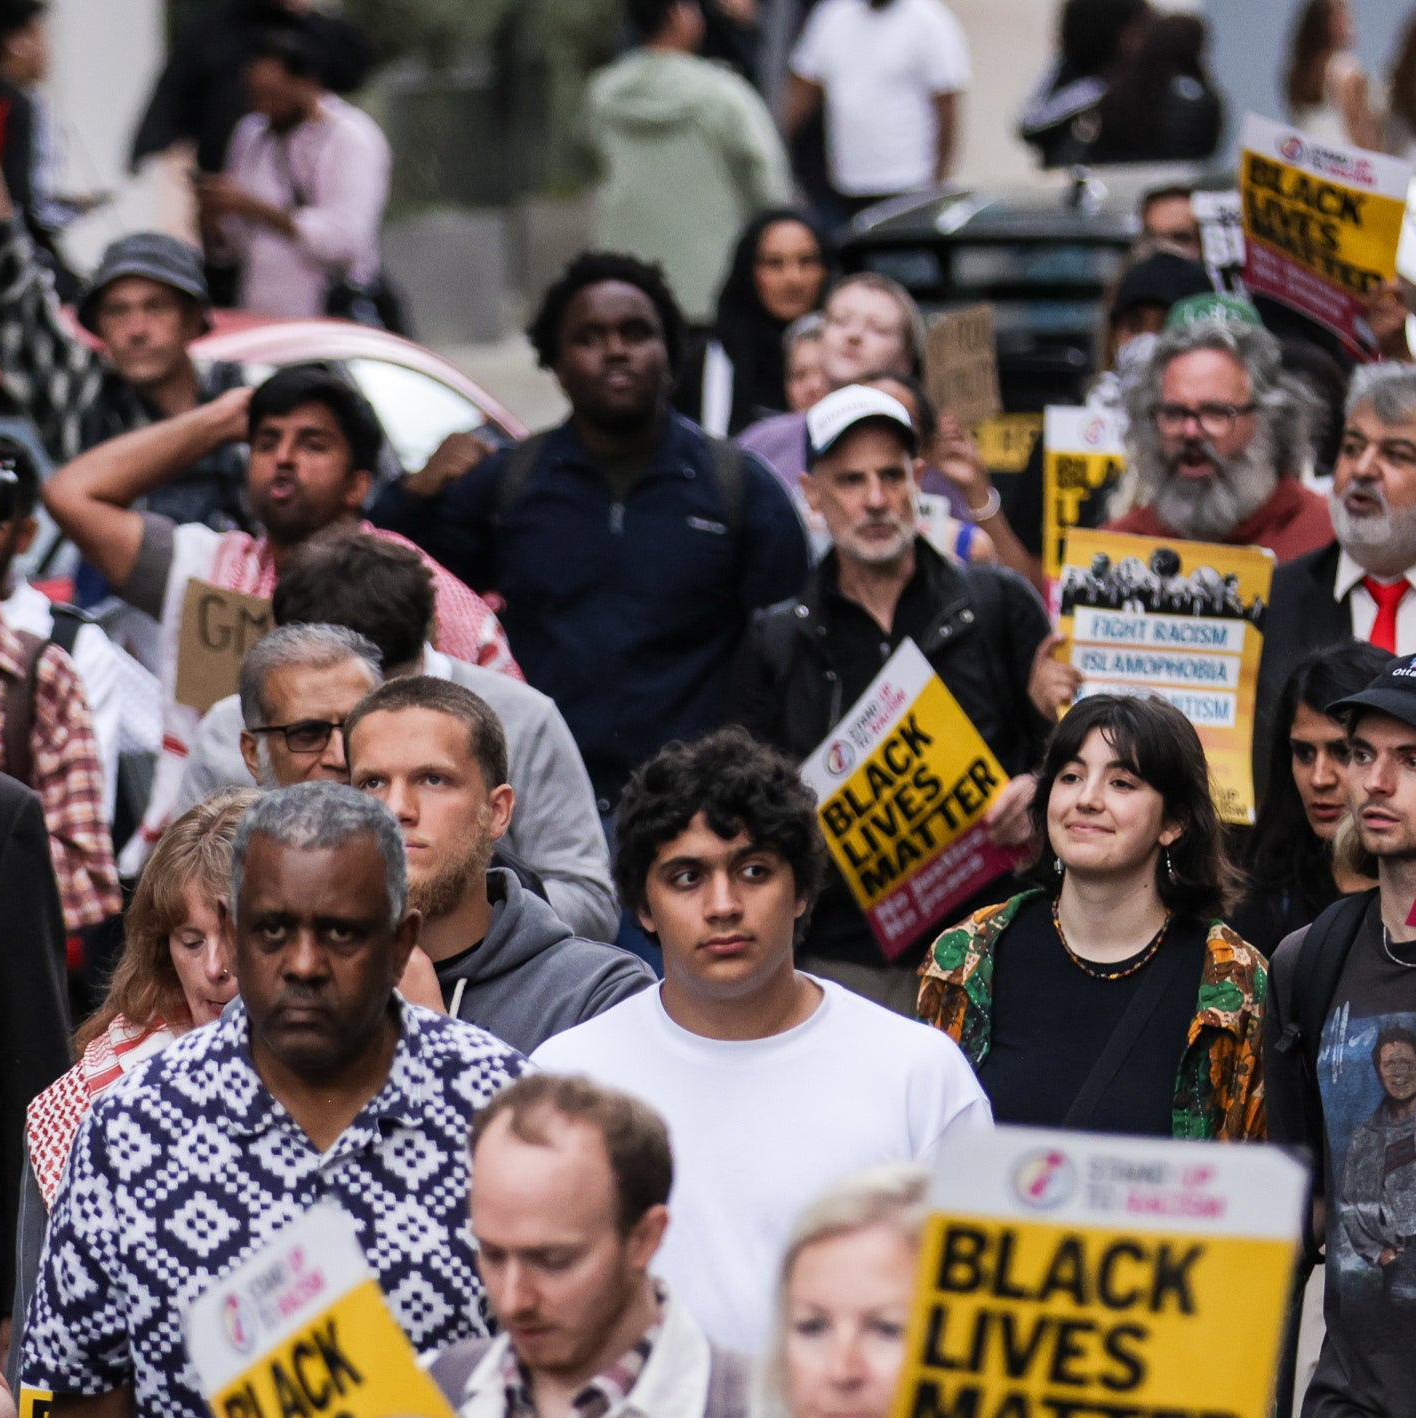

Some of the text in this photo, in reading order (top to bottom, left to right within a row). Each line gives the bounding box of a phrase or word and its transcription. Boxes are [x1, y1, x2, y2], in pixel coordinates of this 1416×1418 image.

[1249, 156, 1367, 226] BLACK
[1092, 614, 1228, 646] FIGHT RACISM
[820, 711, 934, 839] BLACK
[841, 764, 943, 868] LIVES
[858, 756, 999, 900] MATTER
[935, 1222, 1208, 1316] BLACK
[921, 1304, 1150, 1393] LIVES
